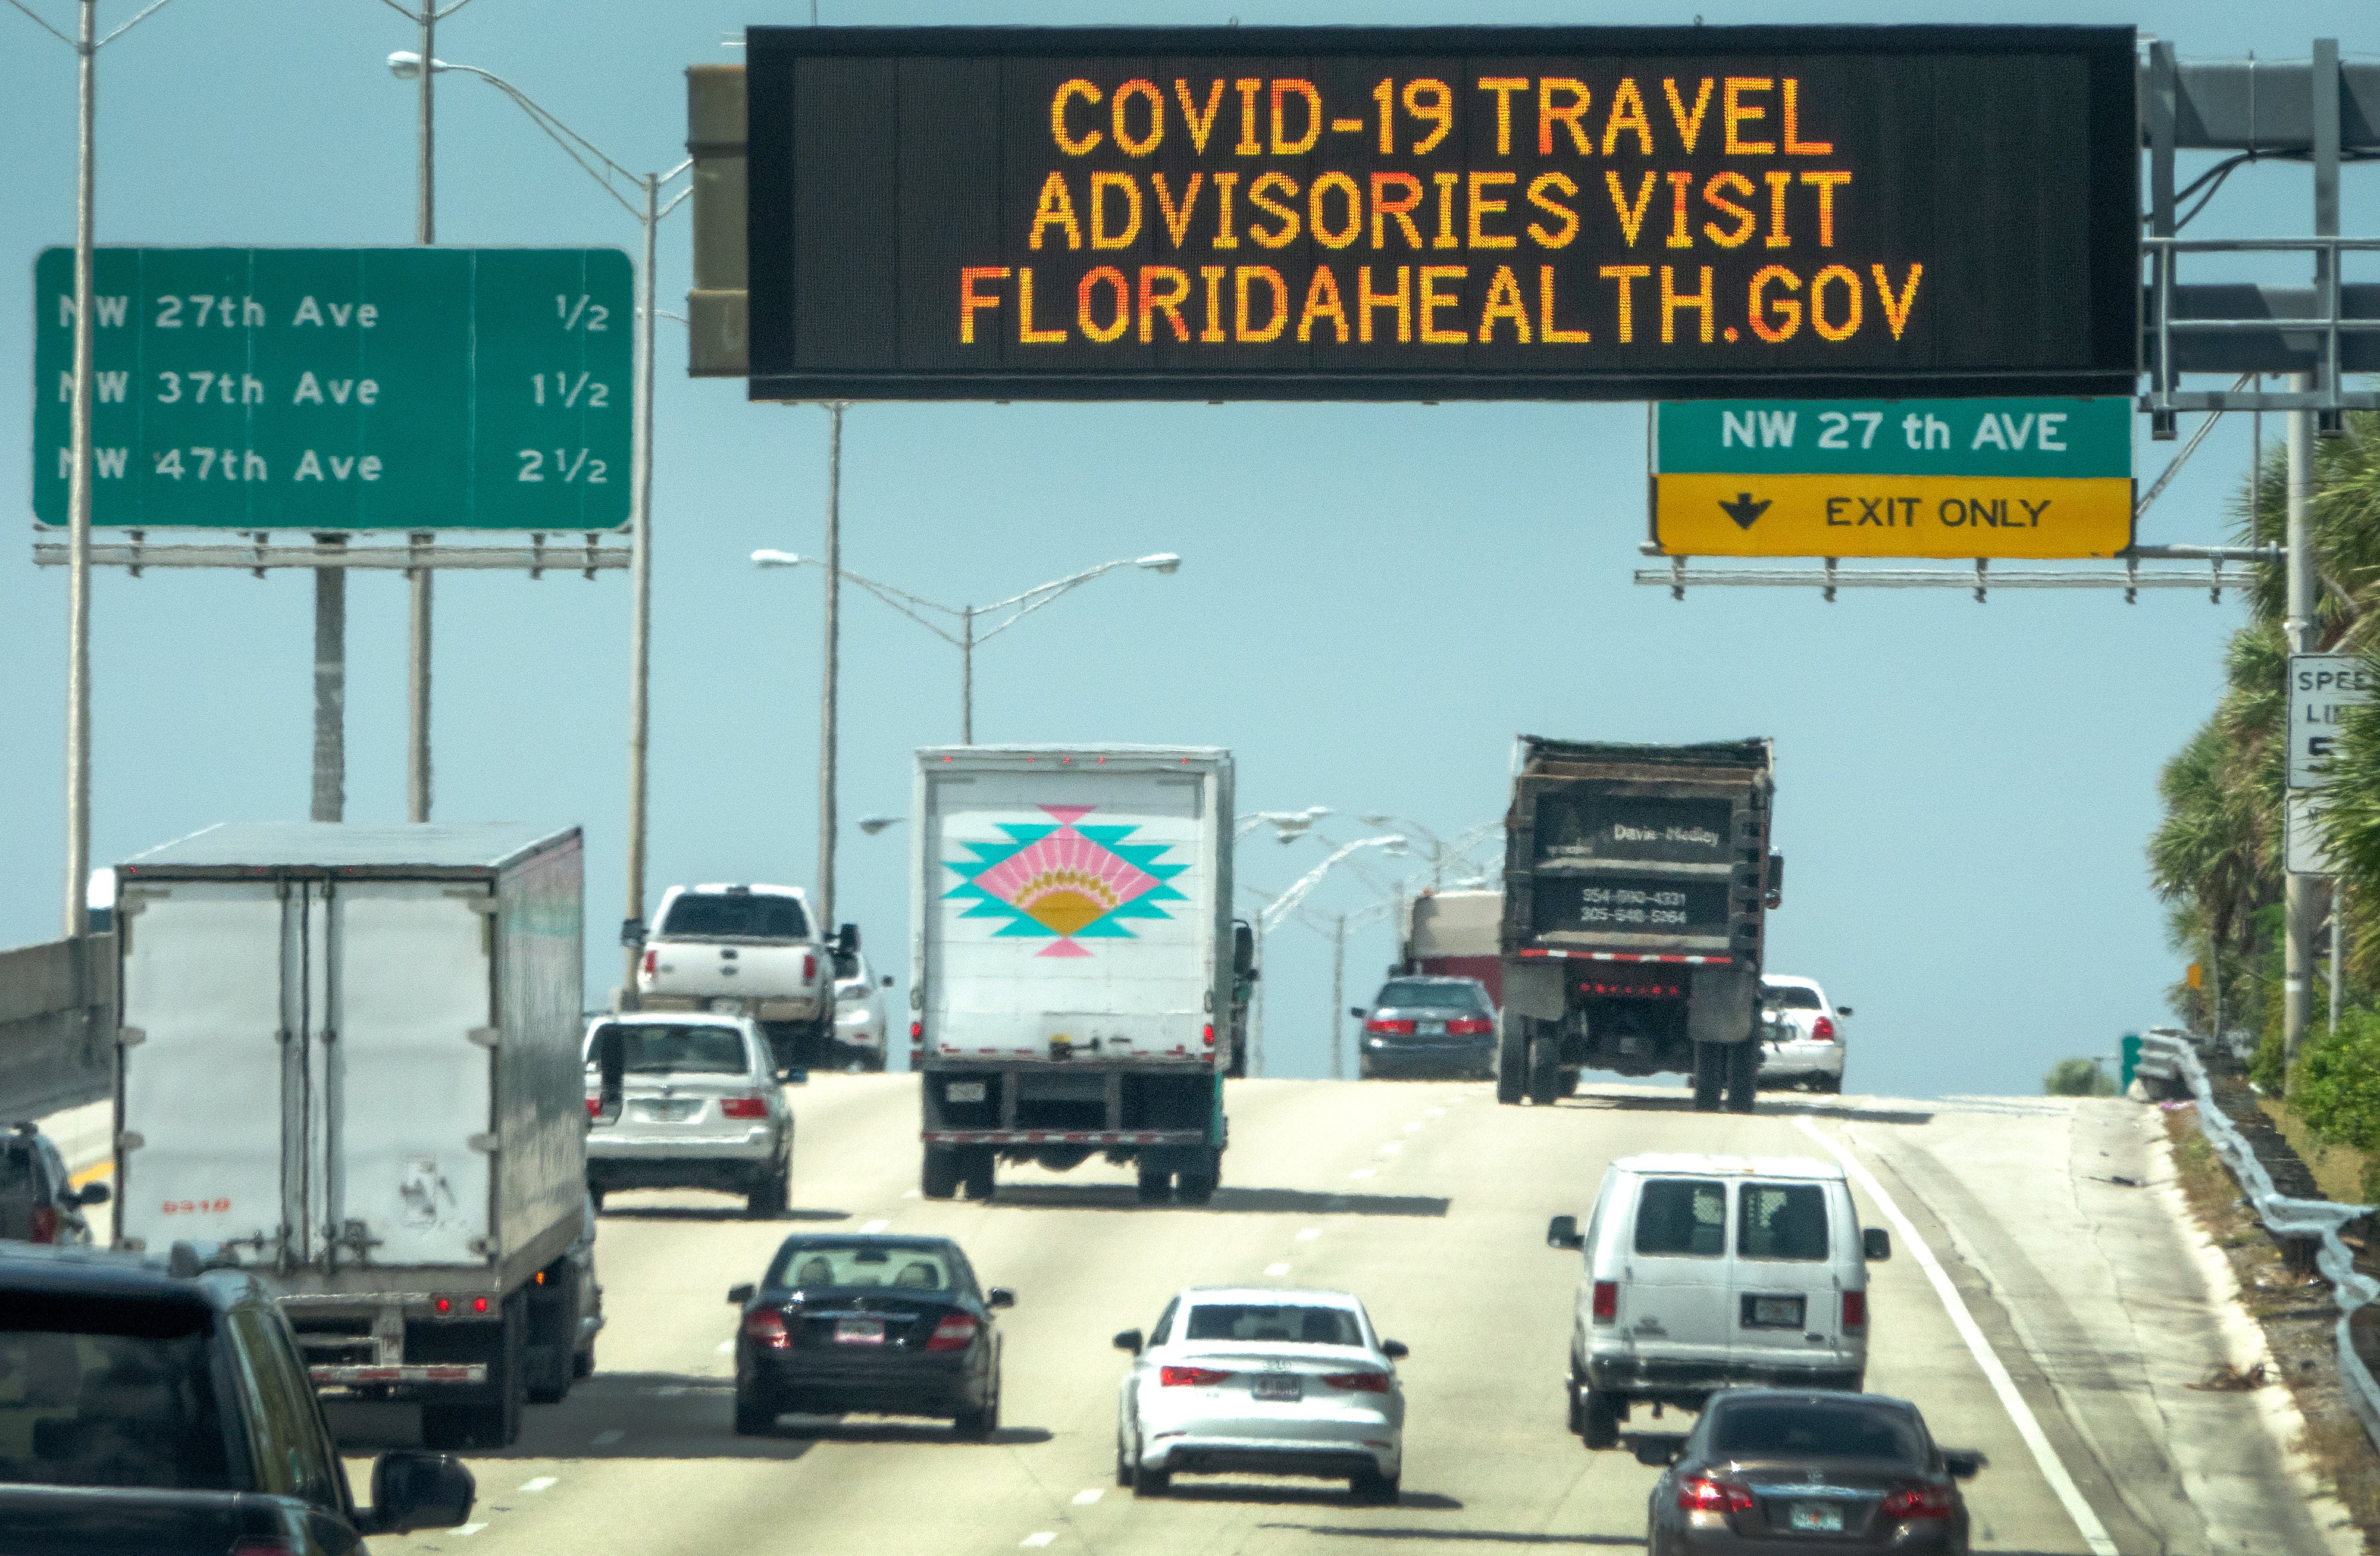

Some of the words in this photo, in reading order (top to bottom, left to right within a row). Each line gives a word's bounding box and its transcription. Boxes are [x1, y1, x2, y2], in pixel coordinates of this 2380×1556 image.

[1051, 77, 1453, 157] COVID-19
[1477, 76, 1834, 156] TRAVEL
[1028, 170, 1580, 251] ADVISORIES
[1605, 170, 1852, 249] VISIT
[155, 294, 265, 328] 27th
[293, 295, 378, 328] Ave
[158, 371, 264, 404] 37th
[293, 371, 379, 405] Ave
[1722, 410, 1797, 448] NW
[1818, 411, 1883, 449] 27
[1902, 412, 1950, 450] th
[1971, 412, 2068, 452] AVE
[155, 446, 268, 481] 47th
[294, 449, 383, 481] Ave
[1825, 496, 1922, 527] EXIT
[1938, 497, 2052, 528] ONLY
